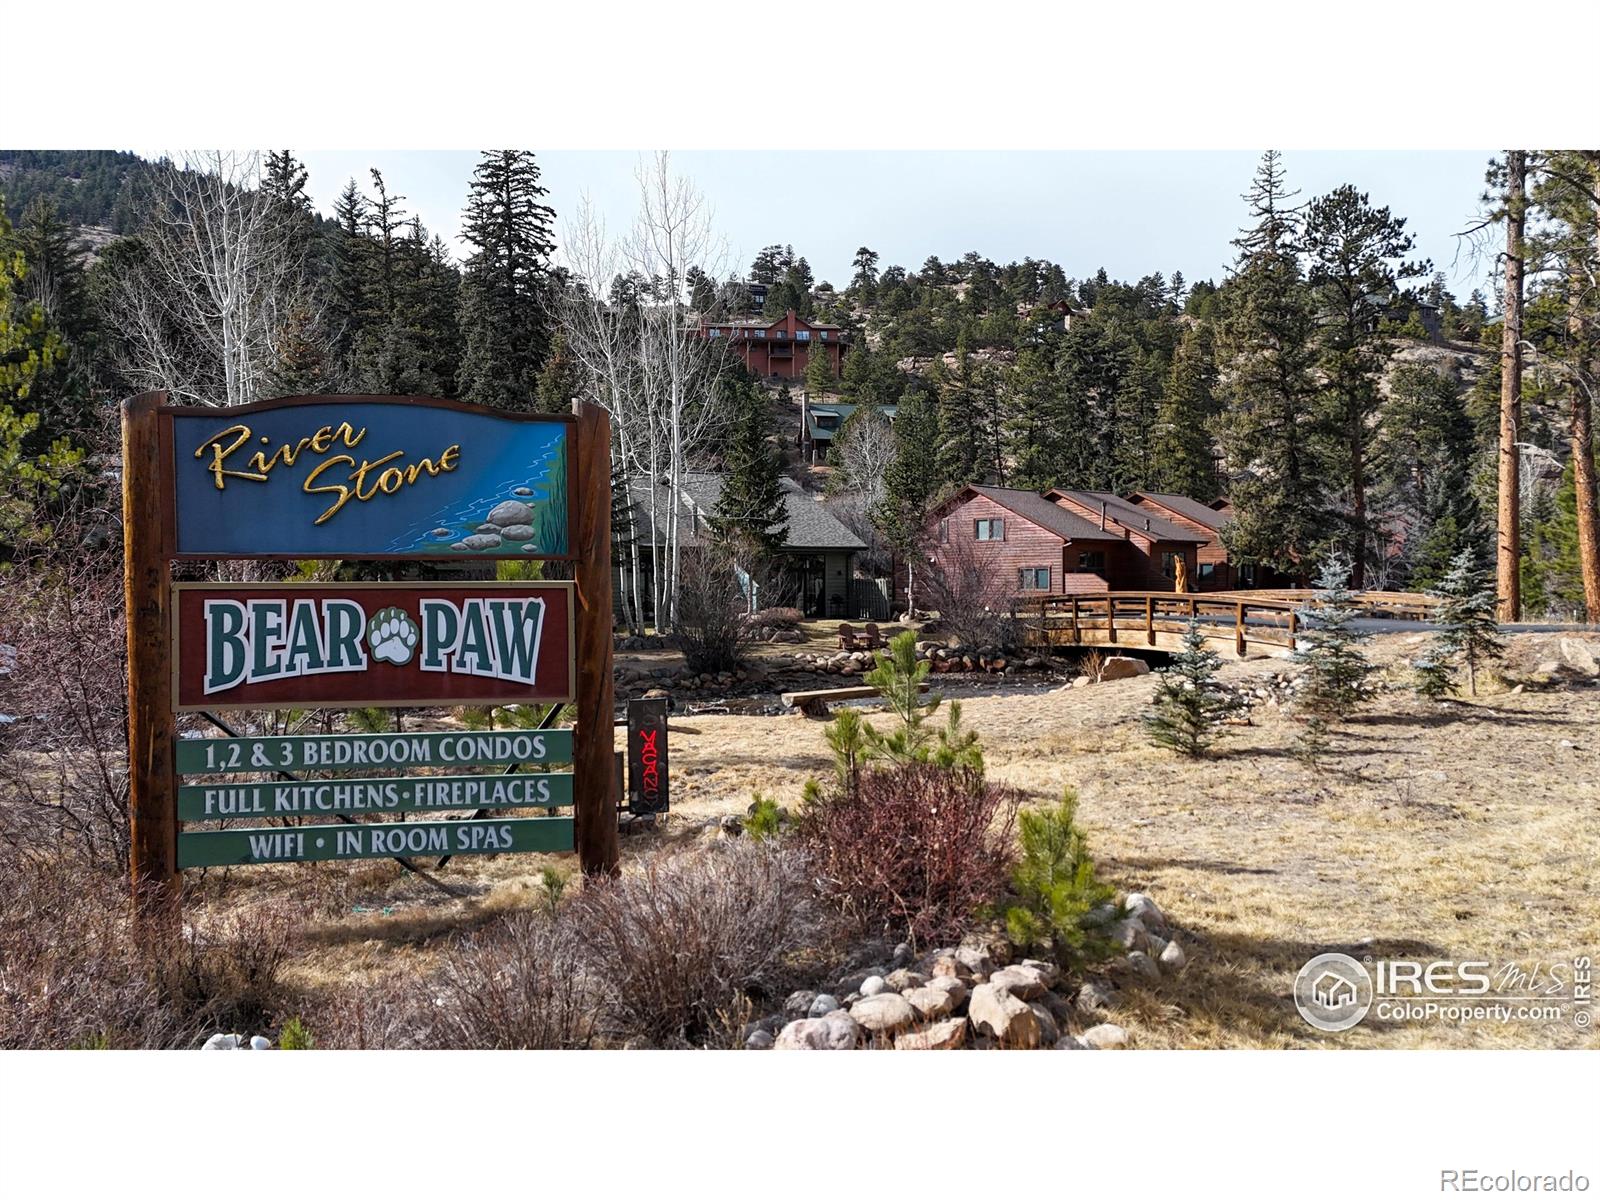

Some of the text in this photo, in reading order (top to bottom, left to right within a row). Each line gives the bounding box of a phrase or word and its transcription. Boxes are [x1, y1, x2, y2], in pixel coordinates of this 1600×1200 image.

[194, 421, 367, 490] River
[303, 443, 461, 526] Stone
[203, 596, 546, 696] BEAR PAW
[205, 735, 547, 772] 1,2 & 3 BEDROOM CONDOS
[204, 779, 550, 815] FULL KITCHENS FIREPLACES
[249, 825, 513, 859] WIFI IN ROOM SPAS
